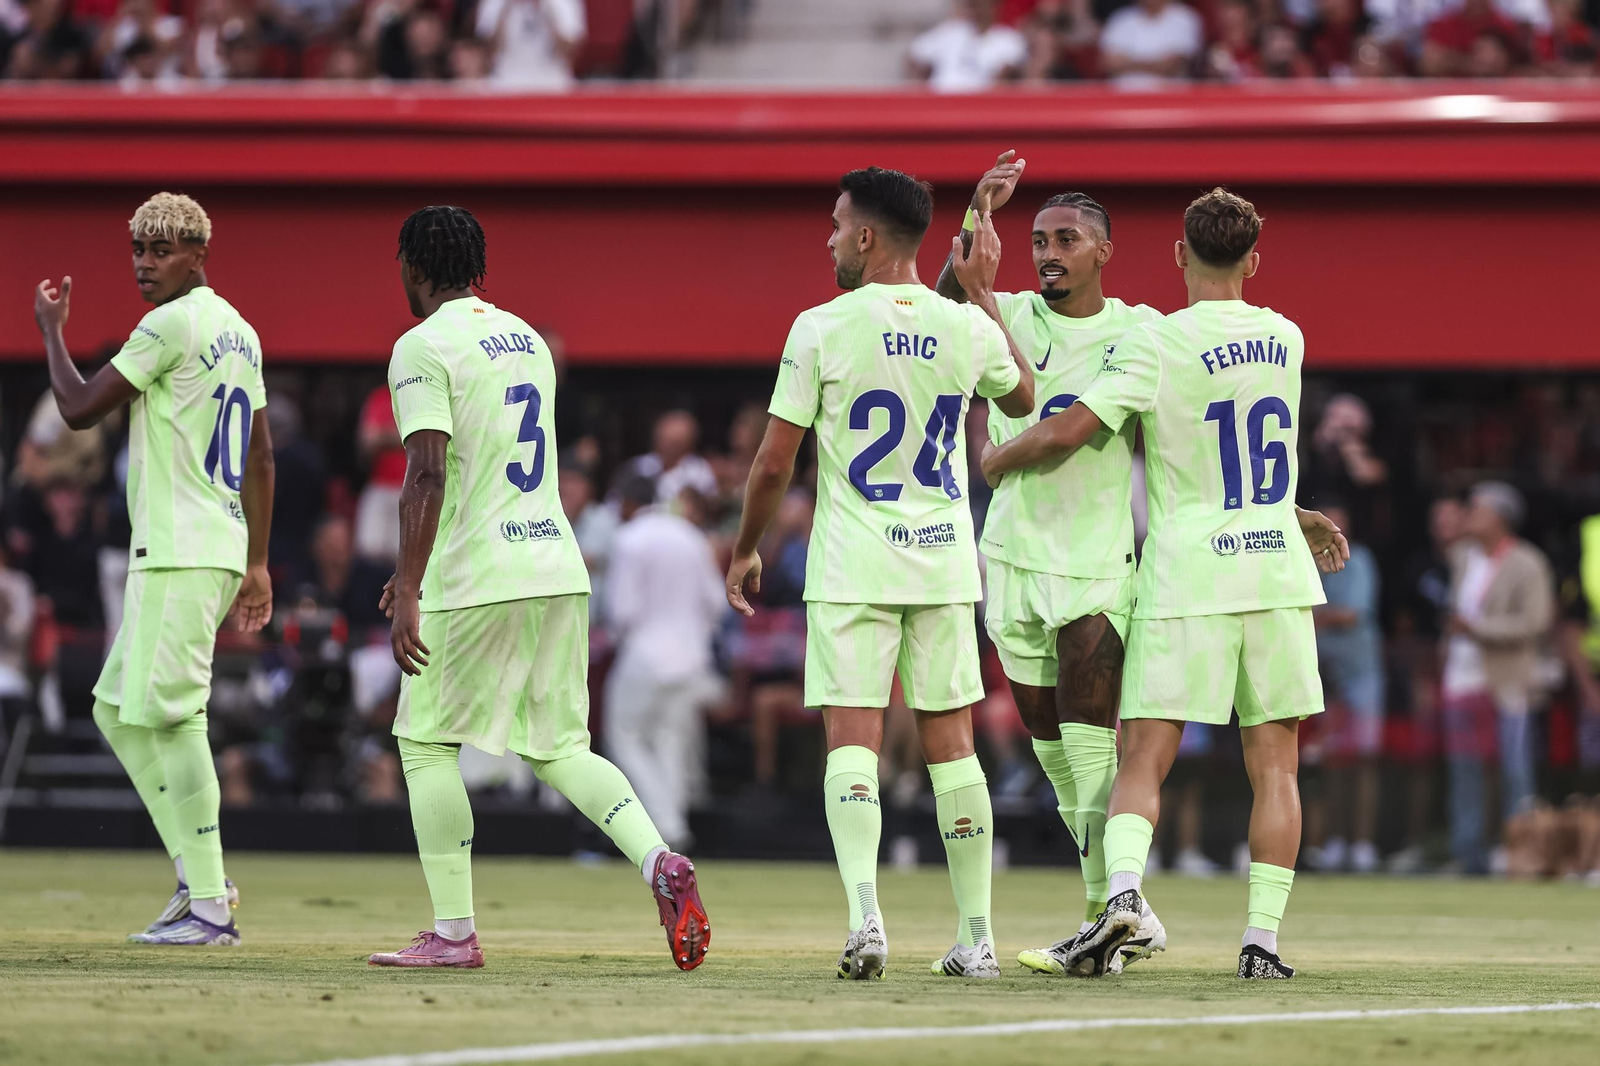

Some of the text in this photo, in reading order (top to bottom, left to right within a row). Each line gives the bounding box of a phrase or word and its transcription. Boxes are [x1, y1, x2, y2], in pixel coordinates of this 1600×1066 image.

[478, 333, 536, 361] BALDE
[882, 332, 938, 360] ERIC
[1200, 336, 1288, 375] FERMÍN
[204, 383, 251, 492] 10
[504, 383, 546, 492] 3
[848, 388, 964, 501] 24
[1203, 396, 1292, 510] 16
[913, 522, 955, 536] UNHCR
[918, 533, 956, 544] ACNUR
[1242, 530, 1284, 540] UNHCR
[1245, 540, 1286, 550] ACNUR
